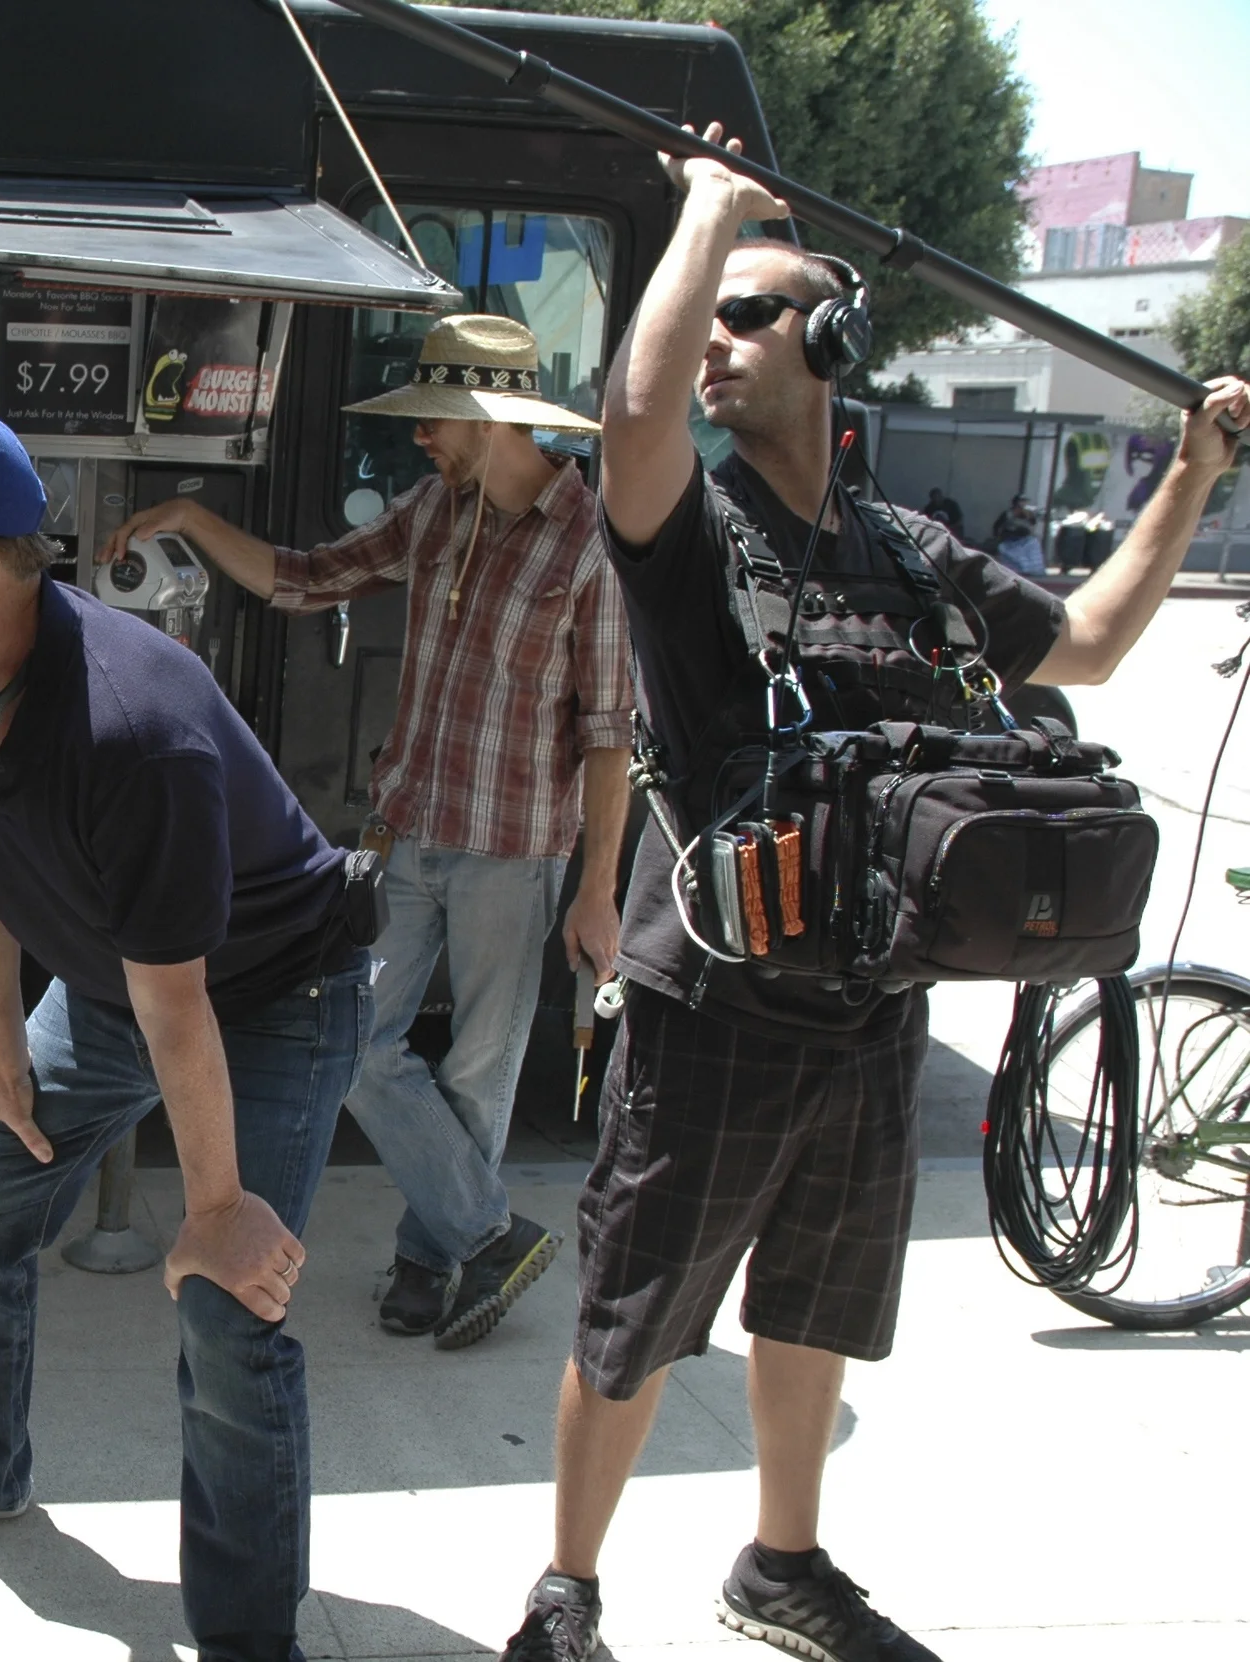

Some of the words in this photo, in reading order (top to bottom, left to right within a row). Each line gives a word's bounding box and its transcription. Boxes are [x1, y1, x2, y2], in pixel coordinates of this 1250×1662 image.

[3, 289, 42, 299] Monster's
[46, 290, 78, 300] Favorite
[80, 291, 99, 301] BBQ
[101, 292, 126, 301] Sauce
[40, 302, 58, 311] Now
[61, 302, 74, 312] For
[10, 327, 53, 338] CHIPOTLE
[61, 328, 106, 340] MOLASSES
[108, 330, 127, 340] BBQ
[16, 360, 110, 395] $7.99
[7, 408, 23, 418] Just
[24, 409, 39, 418] Ask
[42, 409, 55, 418] For
[57, 409, 63, 418] It
[65, 410, 75, 419] At
[76, 410, 89, 420] the
[90, 410, 125, 420] Window
